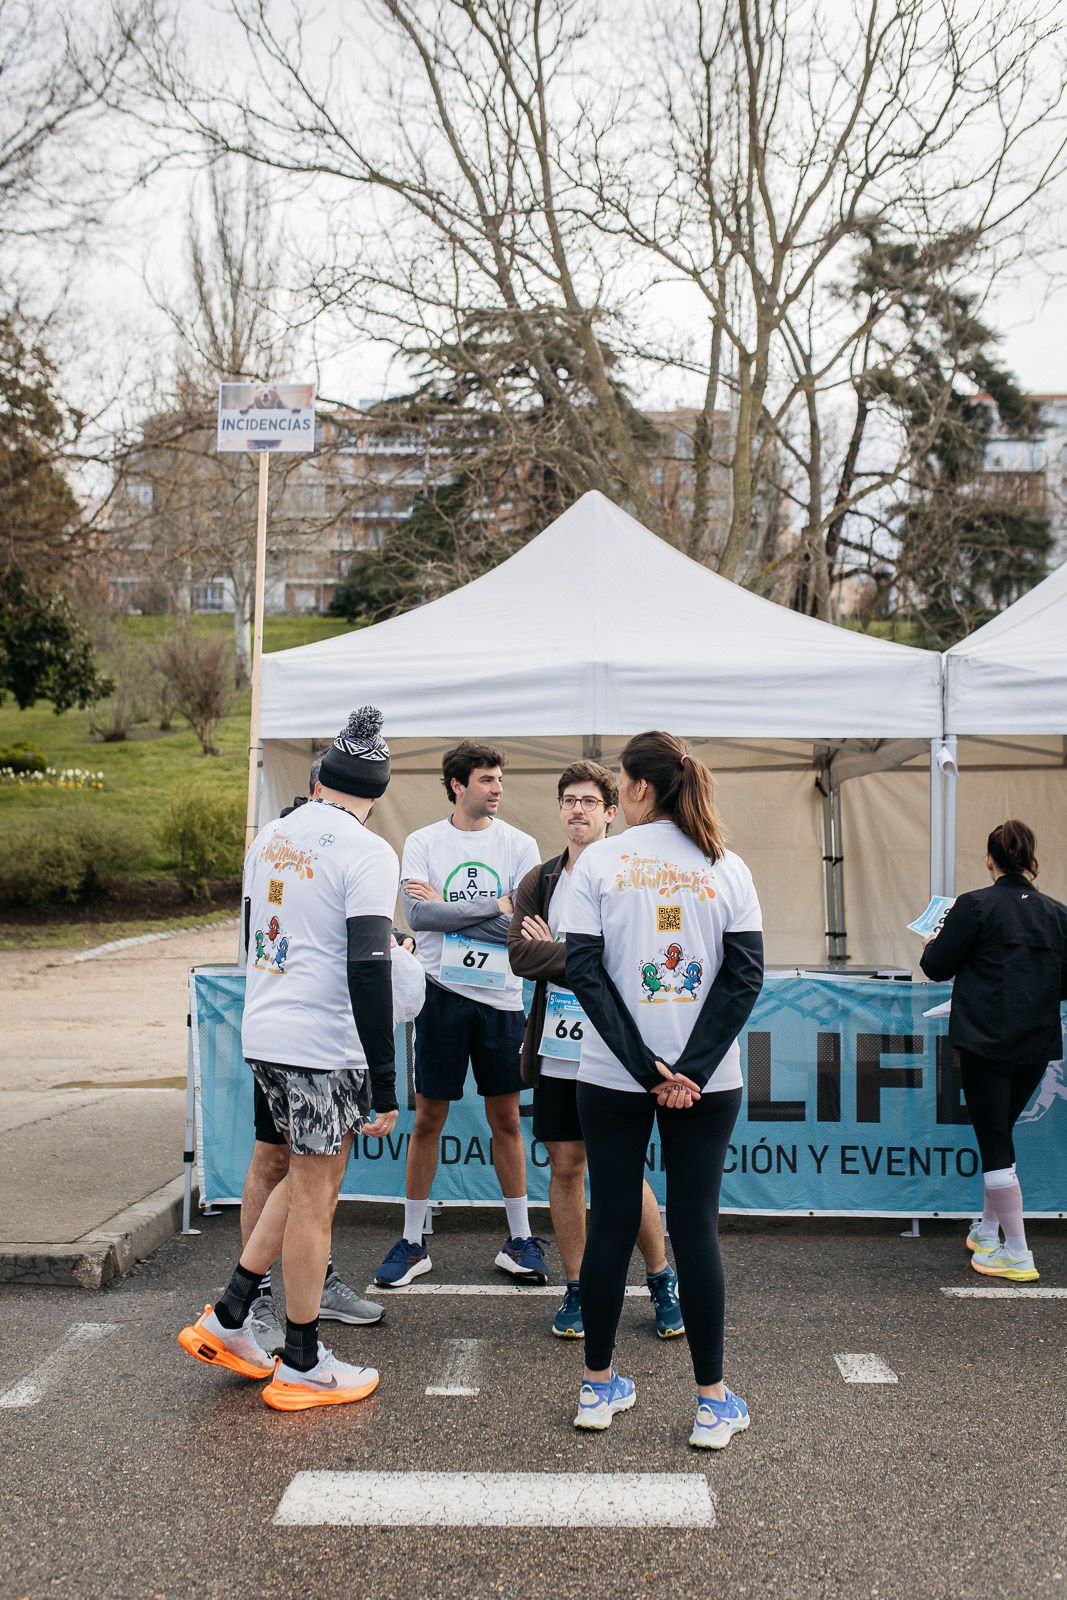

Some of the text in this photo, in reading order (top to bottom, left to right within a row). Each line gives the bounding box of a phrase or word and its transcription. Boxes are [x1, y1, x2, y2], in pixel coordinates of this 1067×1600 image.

[222, 418, 311, 431] INCIDENCIAS
[462, 950, 490, 969] 67
[556, 1020, 584, 1041] 66
[808, 1144, 830, 1174] Y
[840, 1145, 979, 1178] EVENTO
